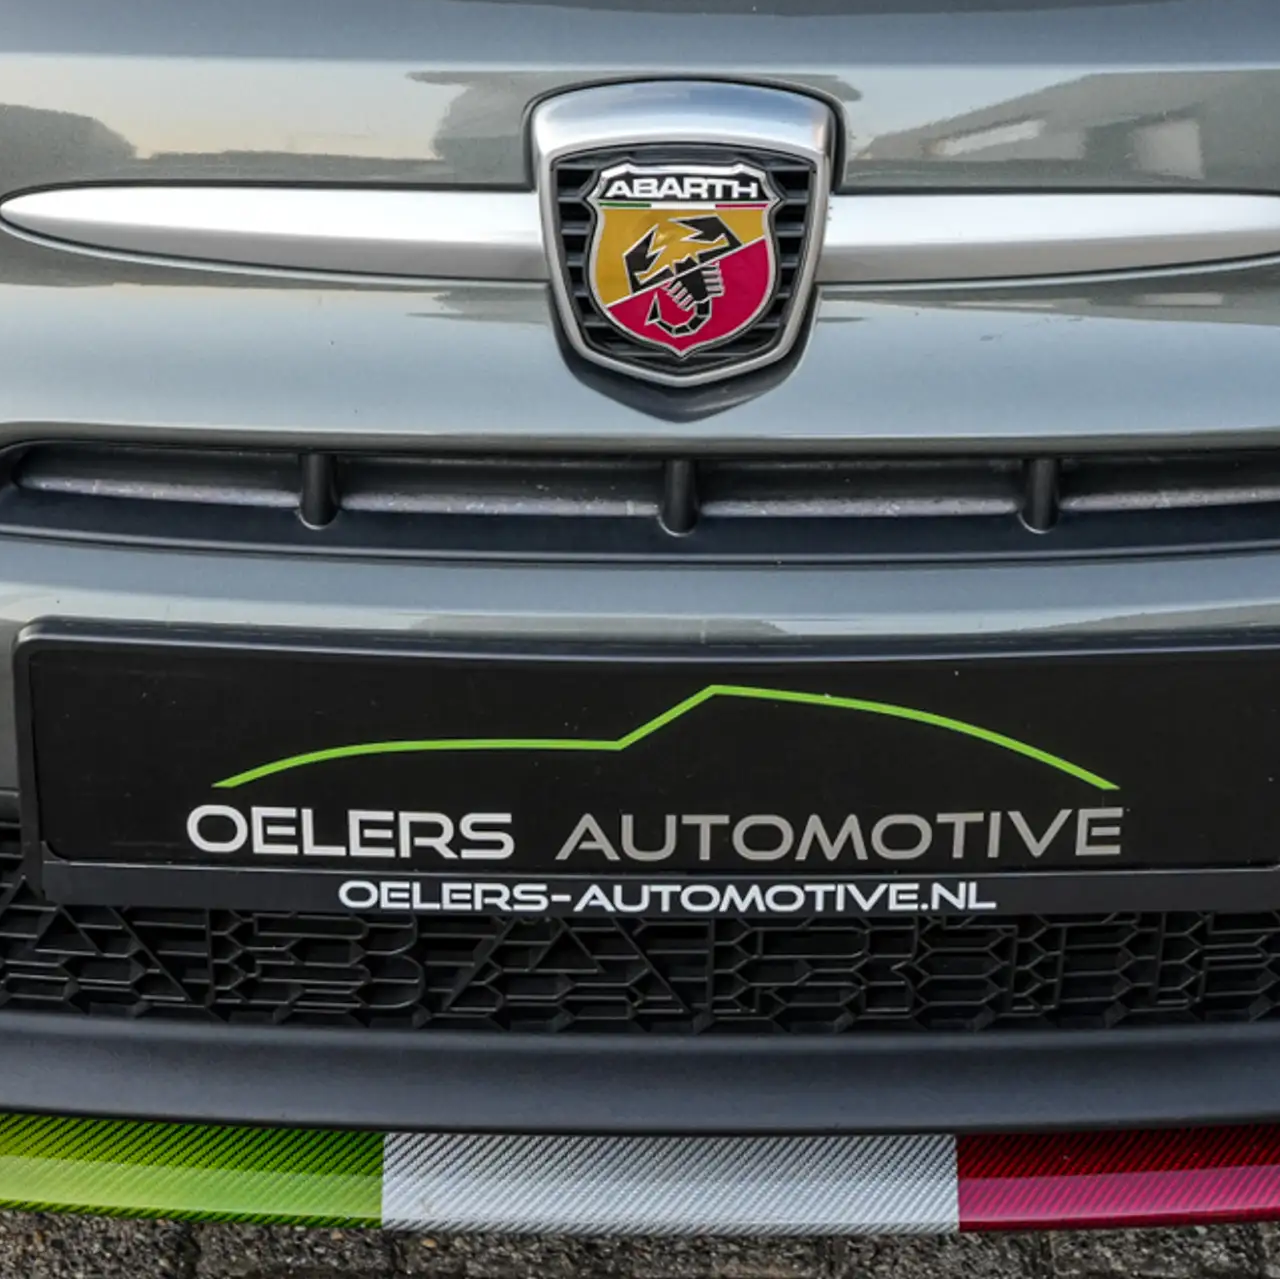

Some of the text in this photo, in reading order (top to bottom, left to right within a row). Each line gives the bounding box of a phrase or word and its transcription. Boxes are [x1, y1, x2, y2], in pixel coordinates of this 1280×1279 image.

[605, 176, 758, 199] ABARTH
[187, 804, 1124, 862] OELERS AUTOMOTIVE
[338, 880, 997, 913] OELERS-AUTOMOTIVE.NL
